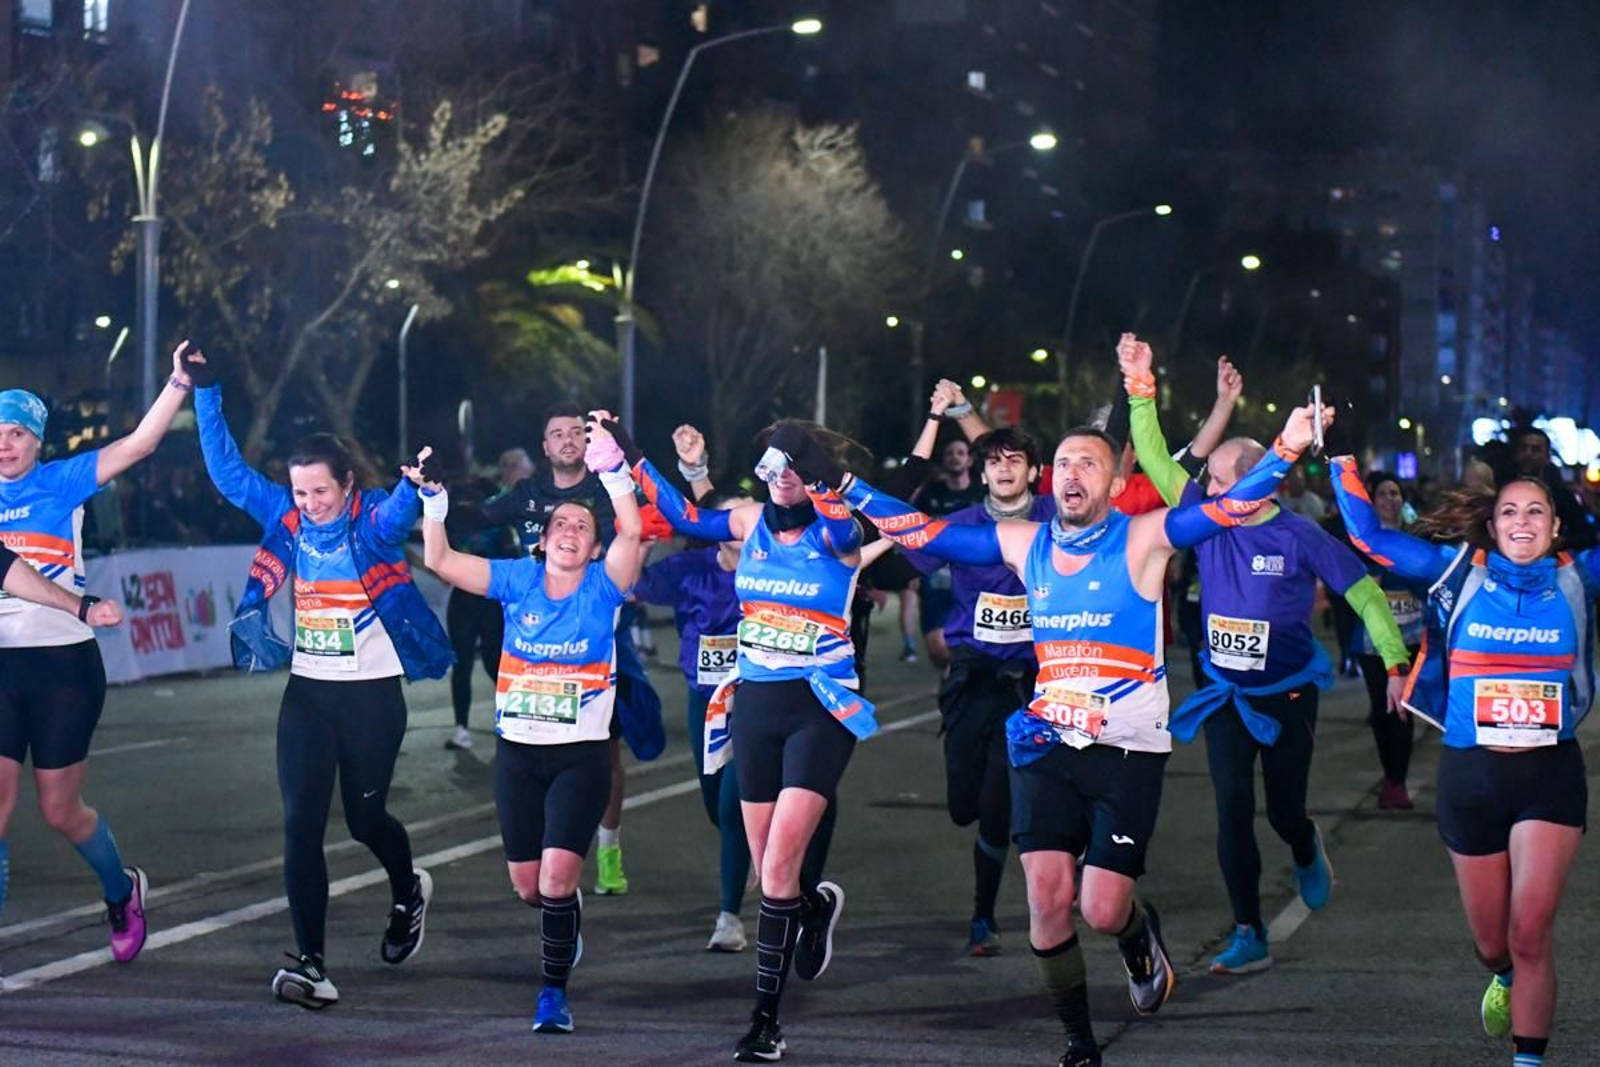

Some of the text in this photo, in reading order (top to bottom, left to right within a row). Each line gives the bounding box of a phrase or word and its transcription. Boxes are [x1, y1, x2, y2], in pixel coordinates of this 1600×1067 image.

[736, 575, 821, 597] enerplus
[1032, 611, 1115, 632] enerplus
[304, 629, 342, 651] 834
[744, 622, 810, 651] 2269
[1211, 630, 1261, 652] 8052
[1467, 621, 1561, 645] enerplus
[514, 637, 591, 659] enerplus
[1044, 642, 1103, 659] Maratón
[1050, 666, 1099, 680] Lucena
[508, 691, 574, 718] 2134
[1491, 697, 1547, 724] 503
[1042, 702, 1089, 731] 508
